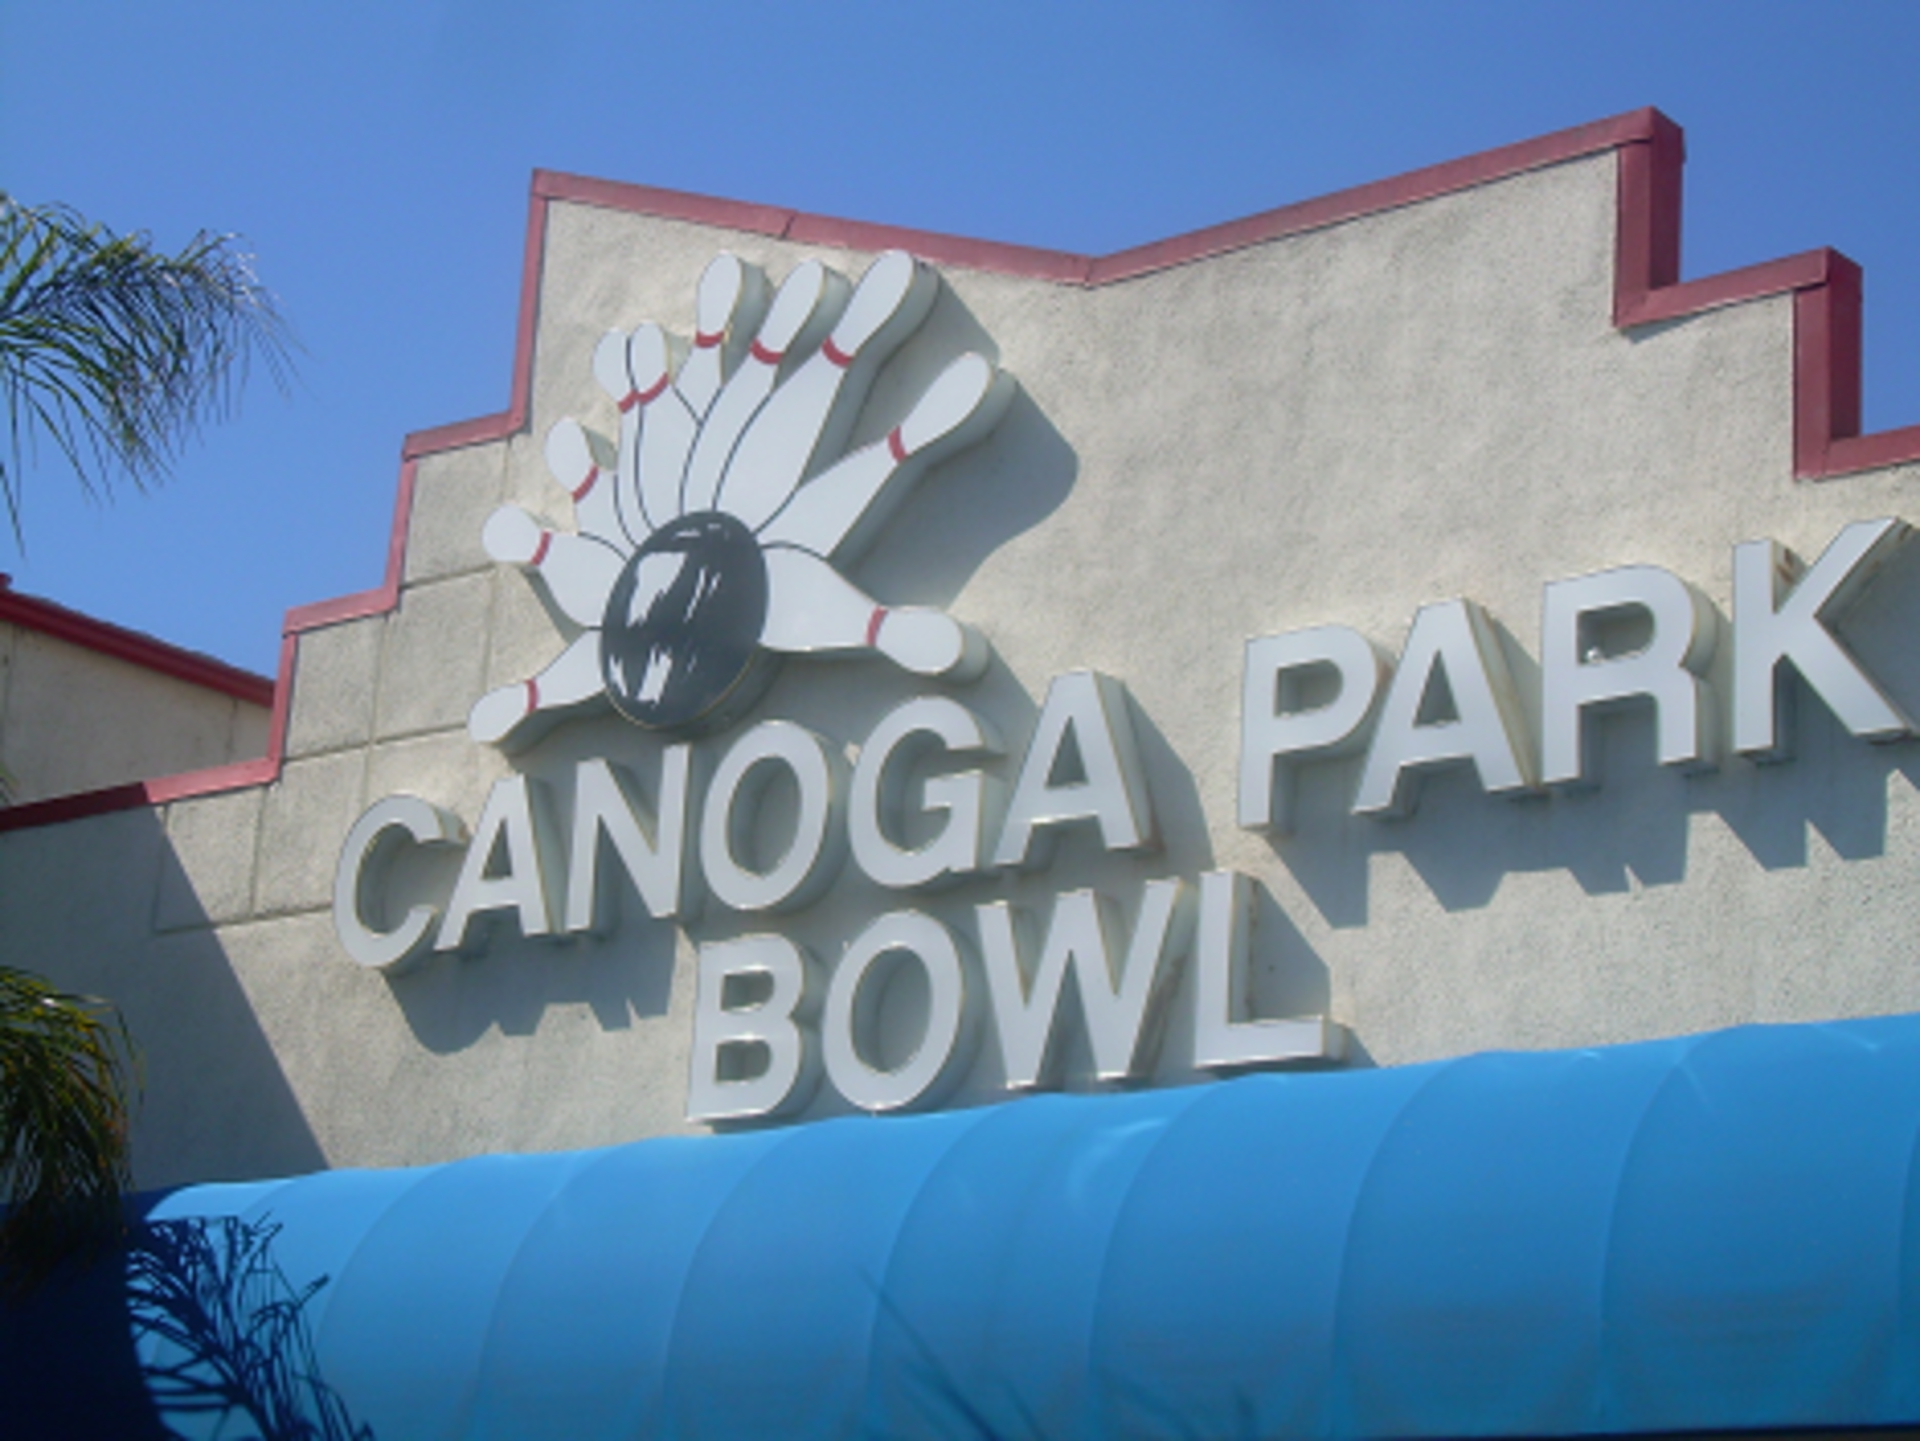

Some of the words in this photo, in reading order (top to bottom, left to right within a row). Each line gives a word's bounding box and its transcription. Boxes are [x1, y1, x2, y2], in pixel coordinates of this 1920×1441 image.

[333, 670, 1145, 968] CANOGA
[1238, 516, 1906, 829] PARK
[688, 870, 1325, 1124] BOWL
